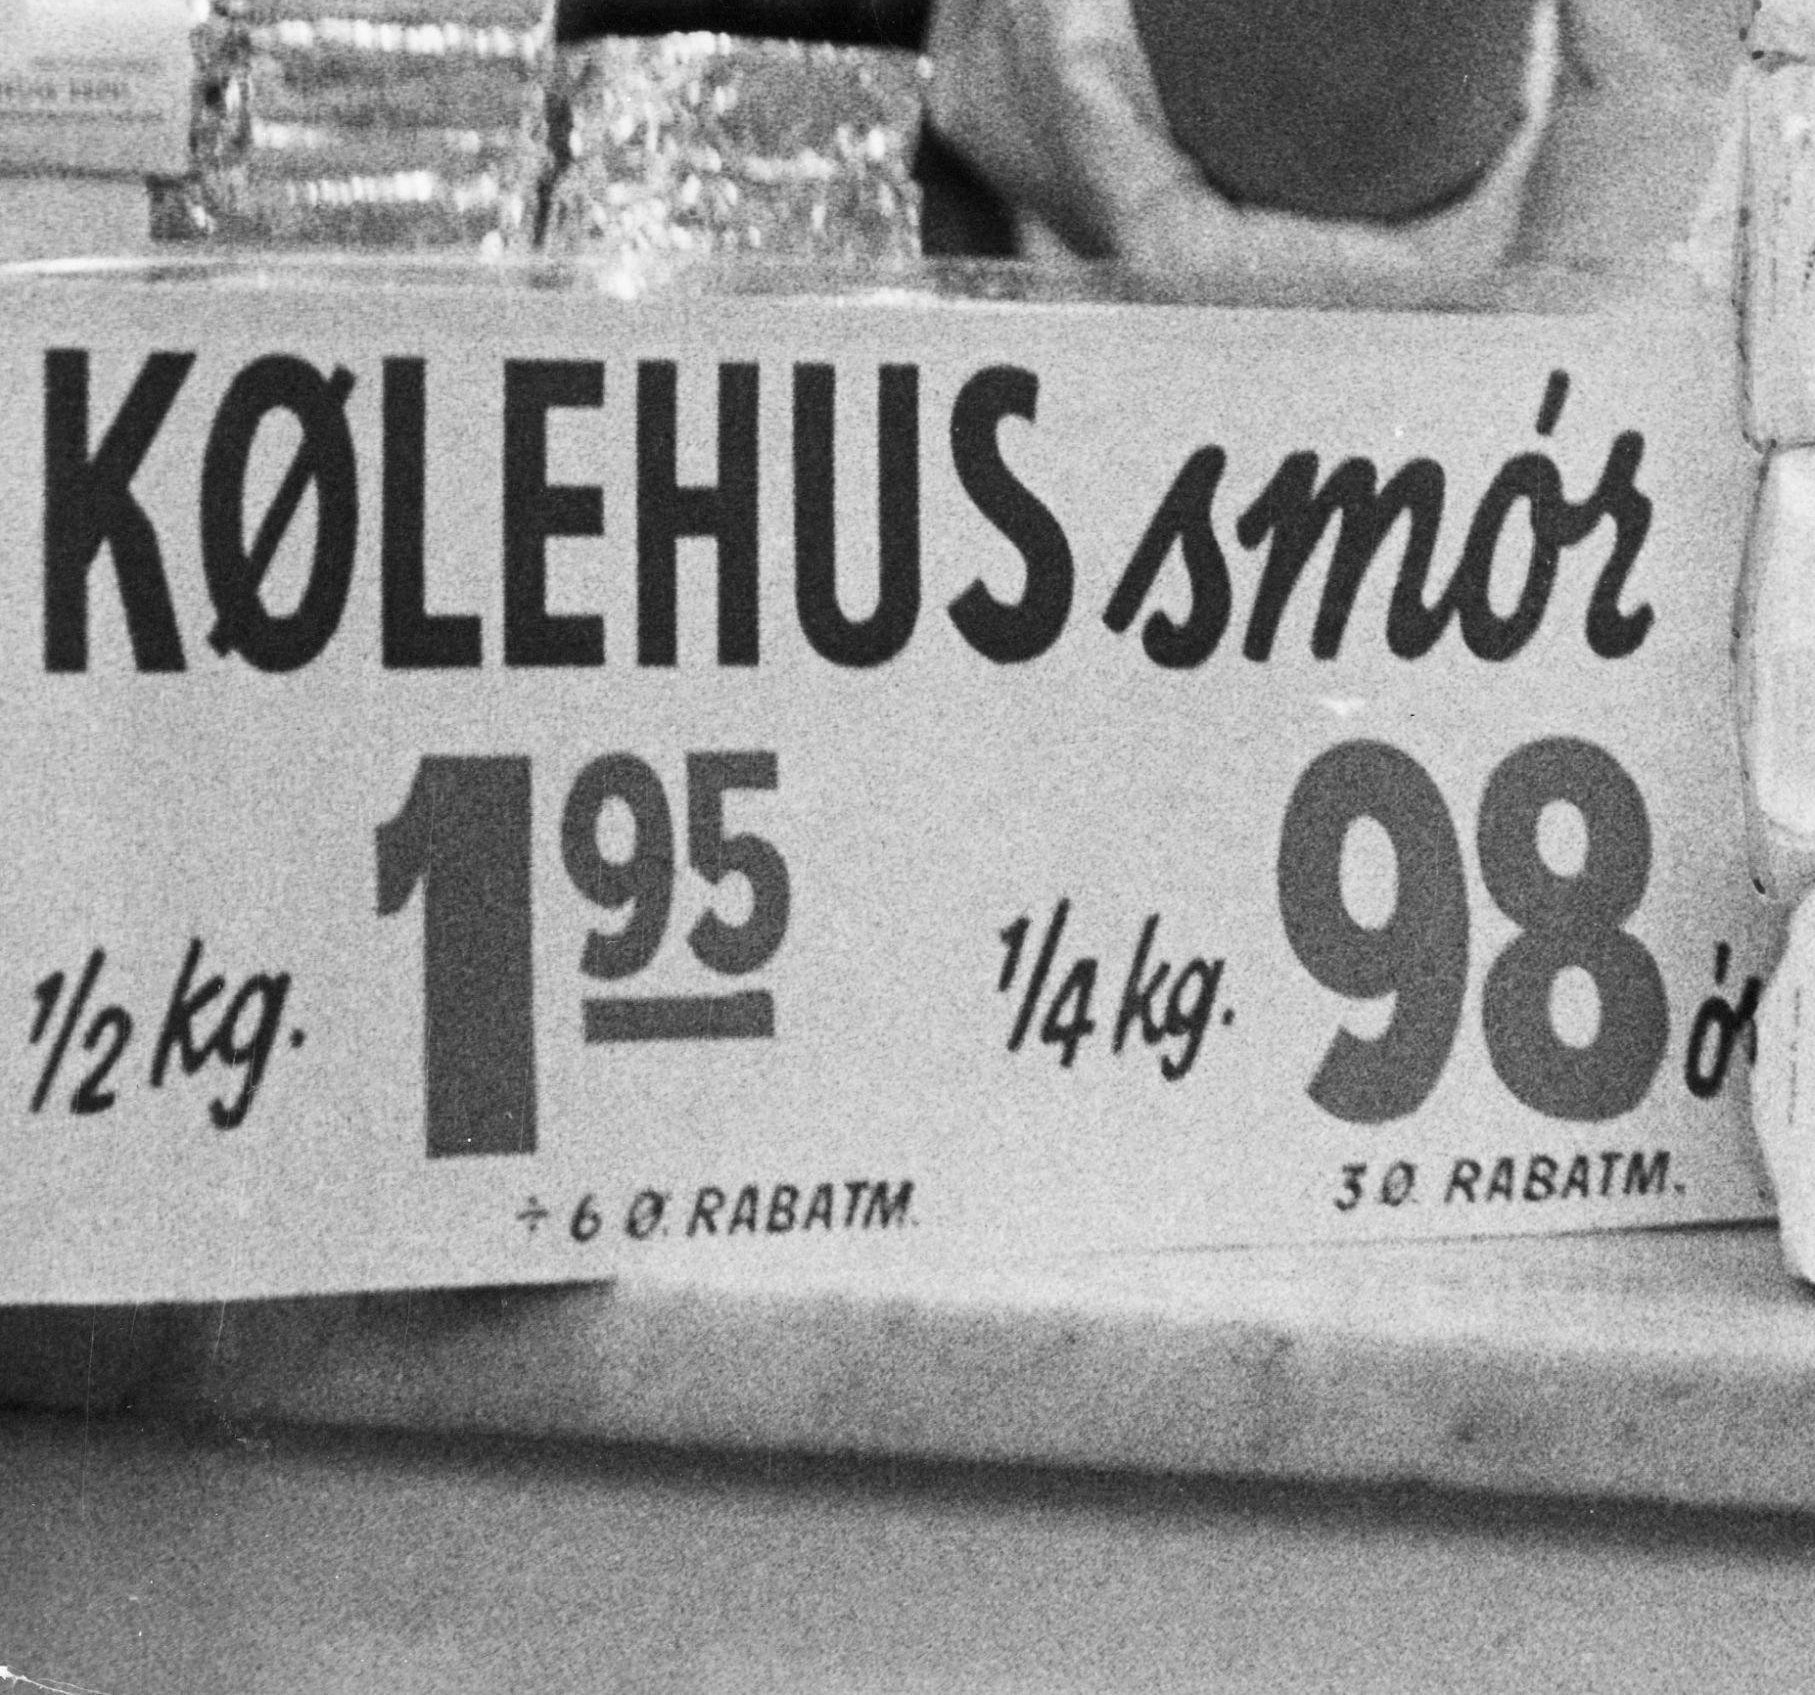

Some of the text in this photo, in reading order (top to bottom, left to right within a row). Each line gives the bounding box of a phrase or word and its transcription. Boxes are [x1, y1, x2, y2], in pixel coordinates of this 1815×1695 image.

[42, 347, 1075, 675] KØLEHUS
[149, 937, 306, 1131] kg.
[1112, 913, 1235, 1082] kg.
[1275, 736, 1673, 1125] 98
[1445, 1148, 1686, 1203] RABATM.
